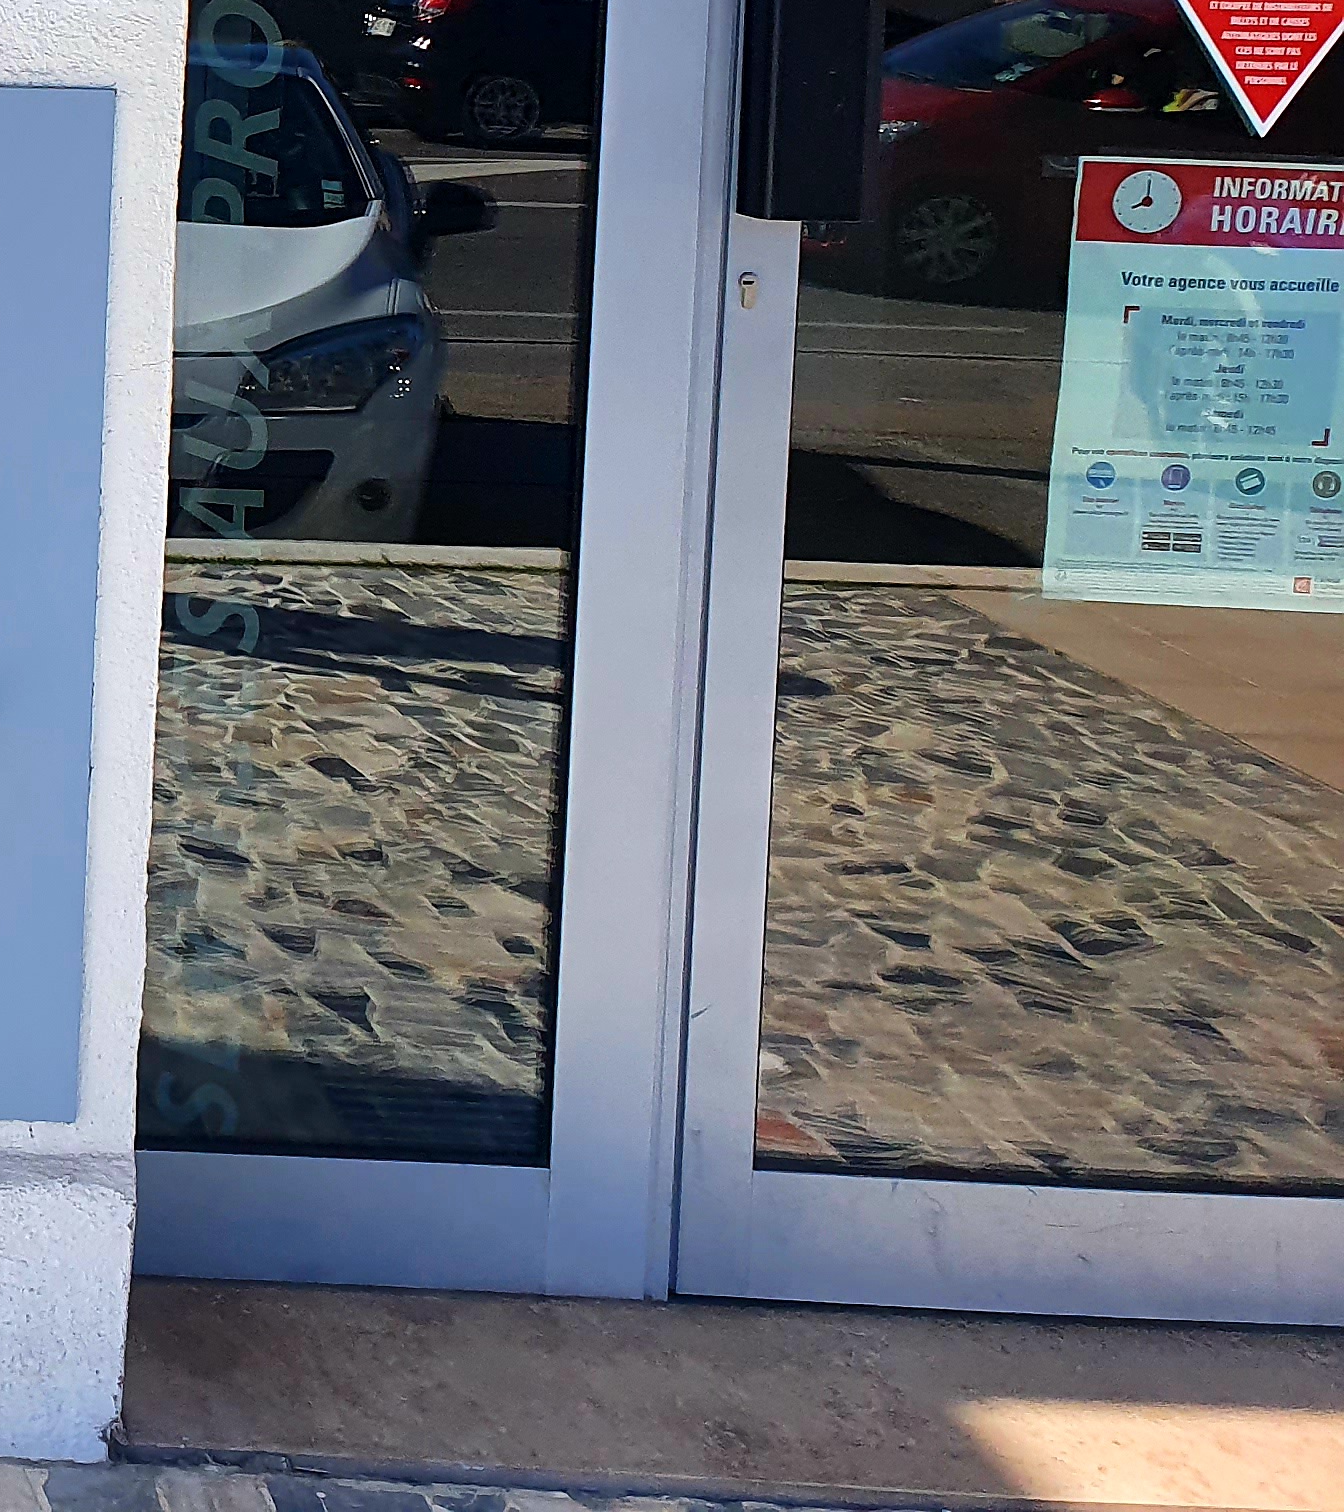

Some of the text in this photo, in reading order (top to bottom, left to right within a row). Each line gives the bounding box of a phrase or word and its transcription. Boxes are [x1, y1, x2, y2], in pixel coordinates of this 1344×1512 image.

[1213, 176, 1344, 202] INFORMAT
[1210, 204, 1344, 236] HORAIR
[1121, 271, 1340, 293] Votre agence vous accueille
[1214, 364, 1245, 374] Jeudi
